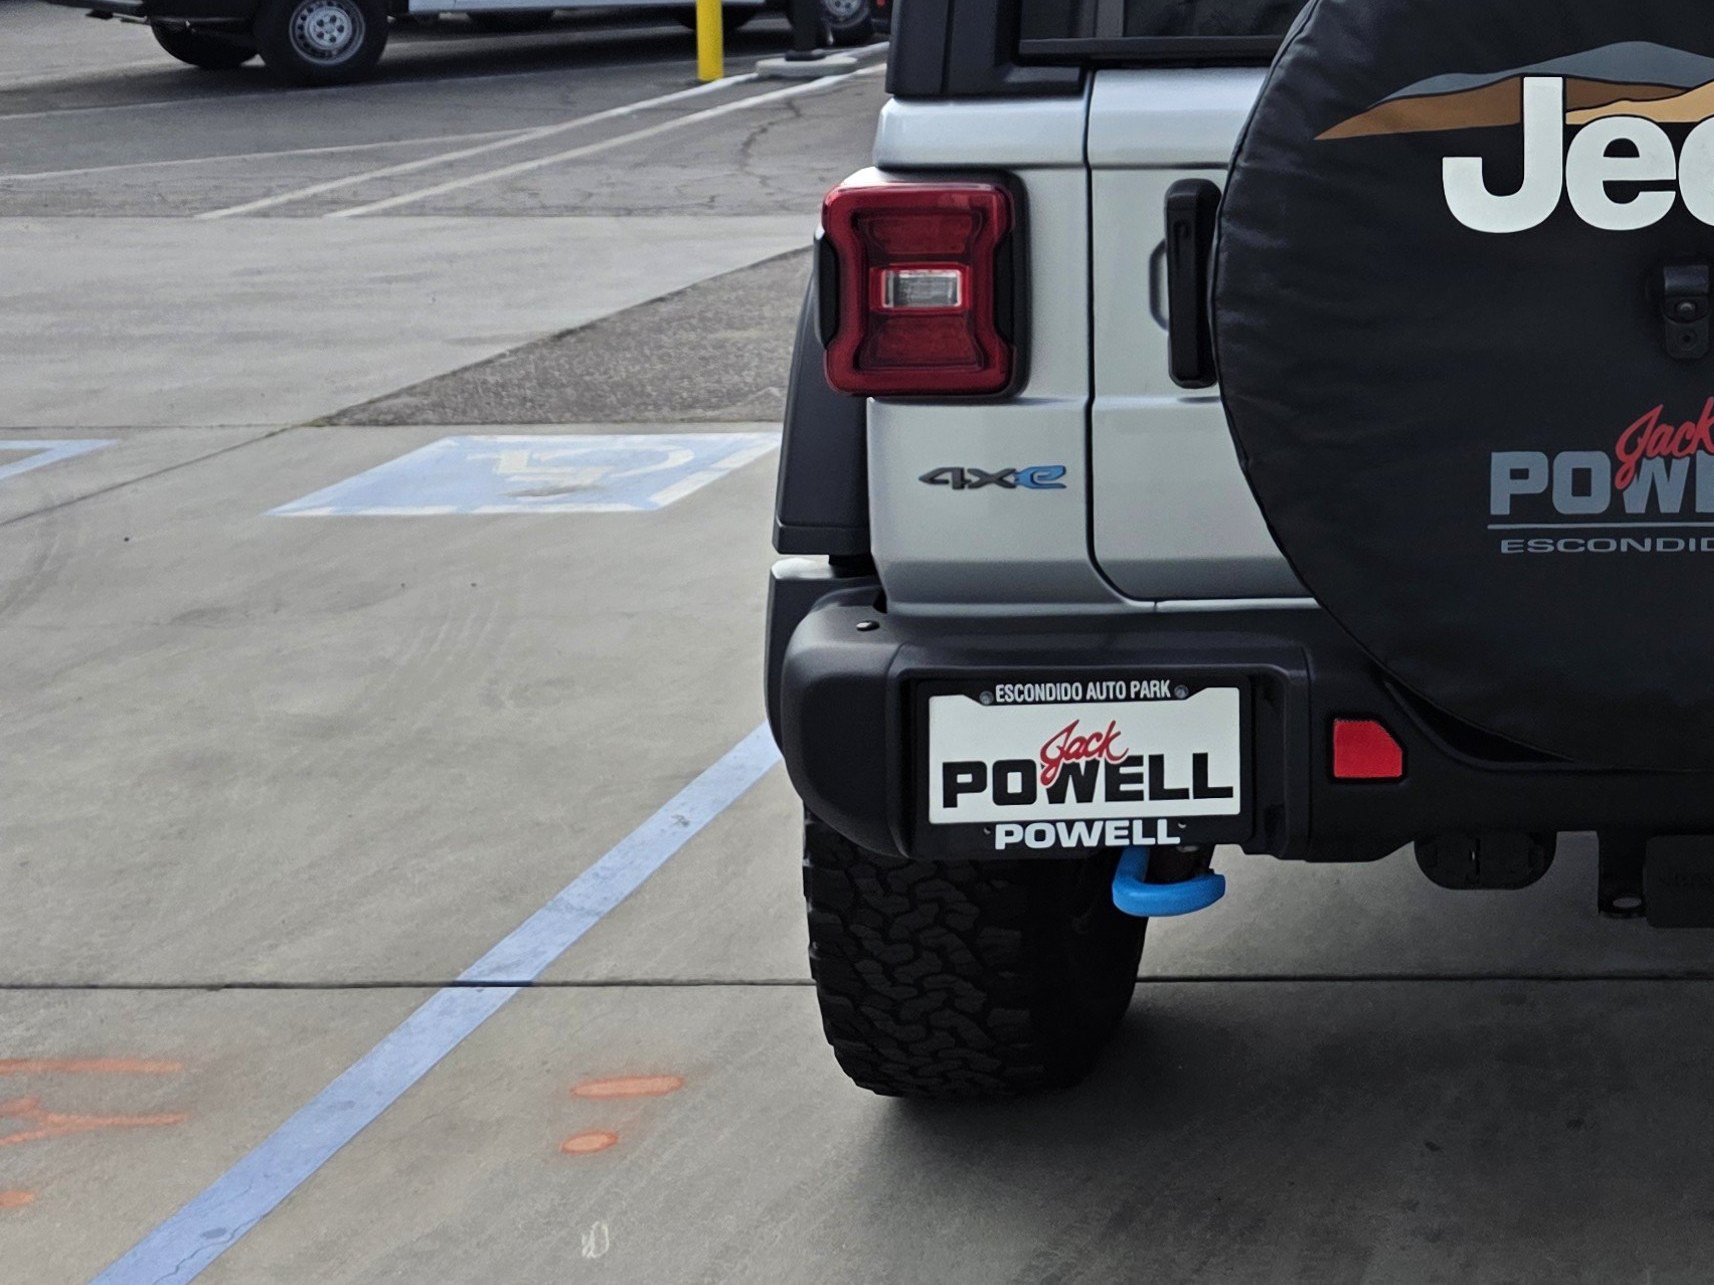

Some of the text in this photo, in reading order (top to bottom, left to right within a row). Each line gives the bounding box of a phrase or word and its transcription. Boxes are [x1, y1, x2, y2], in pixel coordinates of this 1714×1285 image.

[995, 679, 1171, 703] ESCONDIDO AUTO PARK
[1040, 719, 1129, 787] Jack
[942, 752, 1234, 809] POWELL
[994, 818, 1181, 850] POWELL
